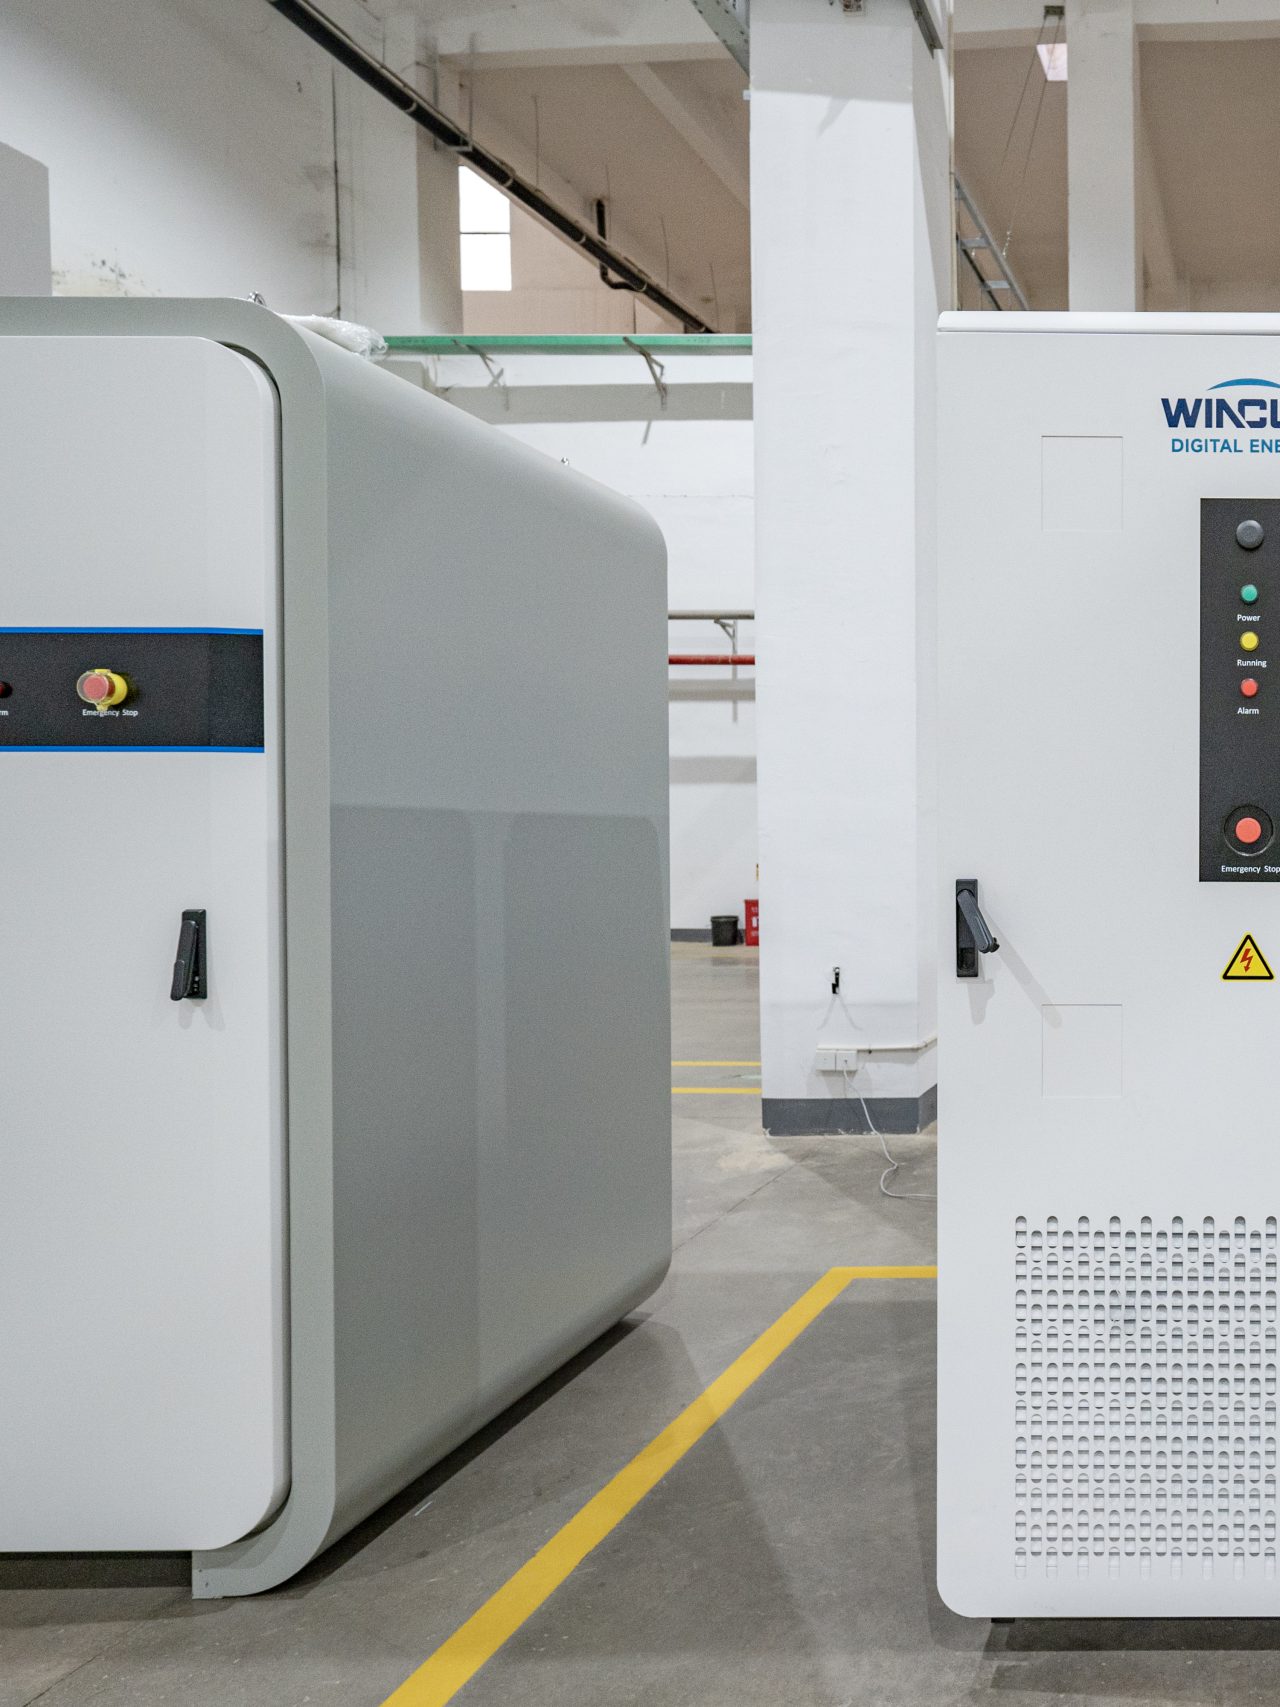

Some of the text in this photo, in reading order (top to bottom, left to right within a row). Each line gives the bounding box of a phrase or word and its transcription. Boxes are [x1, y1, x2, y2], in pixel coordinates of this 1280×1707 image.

[1171, 438, 1243, 453] DIGITAL
[1237, 614, 1261, 622] Power
[1237, 659, 1267, 668] Running
[82, 708, 139, 718] Emergency Stop
[1237, 707, 1260, 715] Alarm
[1221, 865, 1280, 874] Emergency Stop
